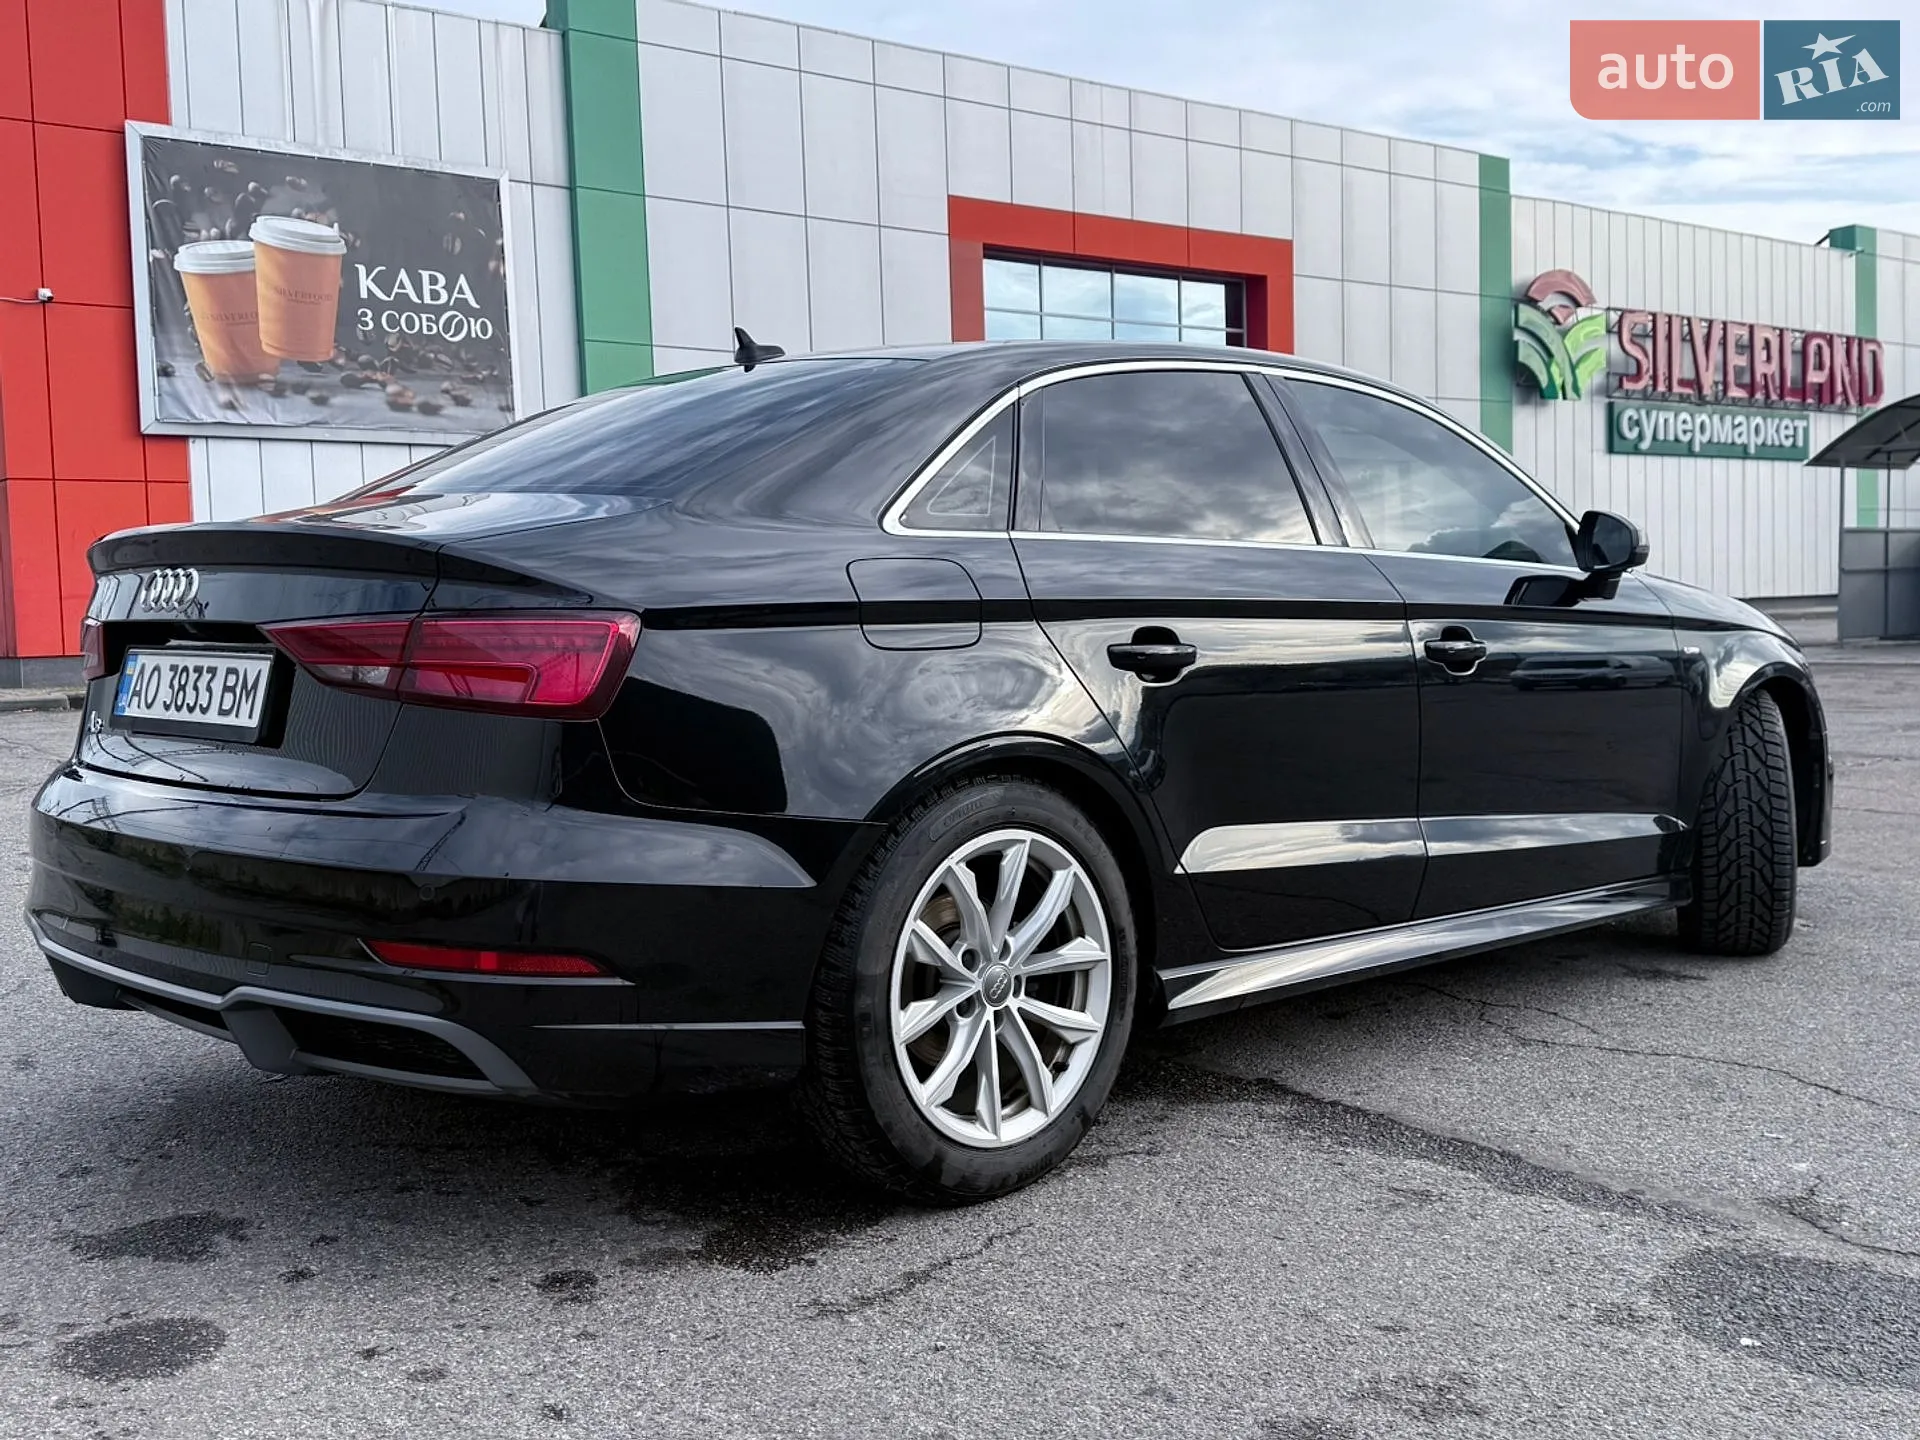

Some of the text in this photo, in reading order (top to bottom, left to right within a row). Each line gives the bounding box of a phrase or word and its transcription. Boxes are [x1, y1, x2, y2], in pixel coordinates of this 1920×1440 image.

[355, 264, 480, 309] КАВА
[357, 308, 493, 342] З СОБОЮ
[1619, 310, 1885, 407] SILVERLAND
[1620, 407, 1808, 454] супермаркет
[128, 662, 262, 719] AO 3833 BM
